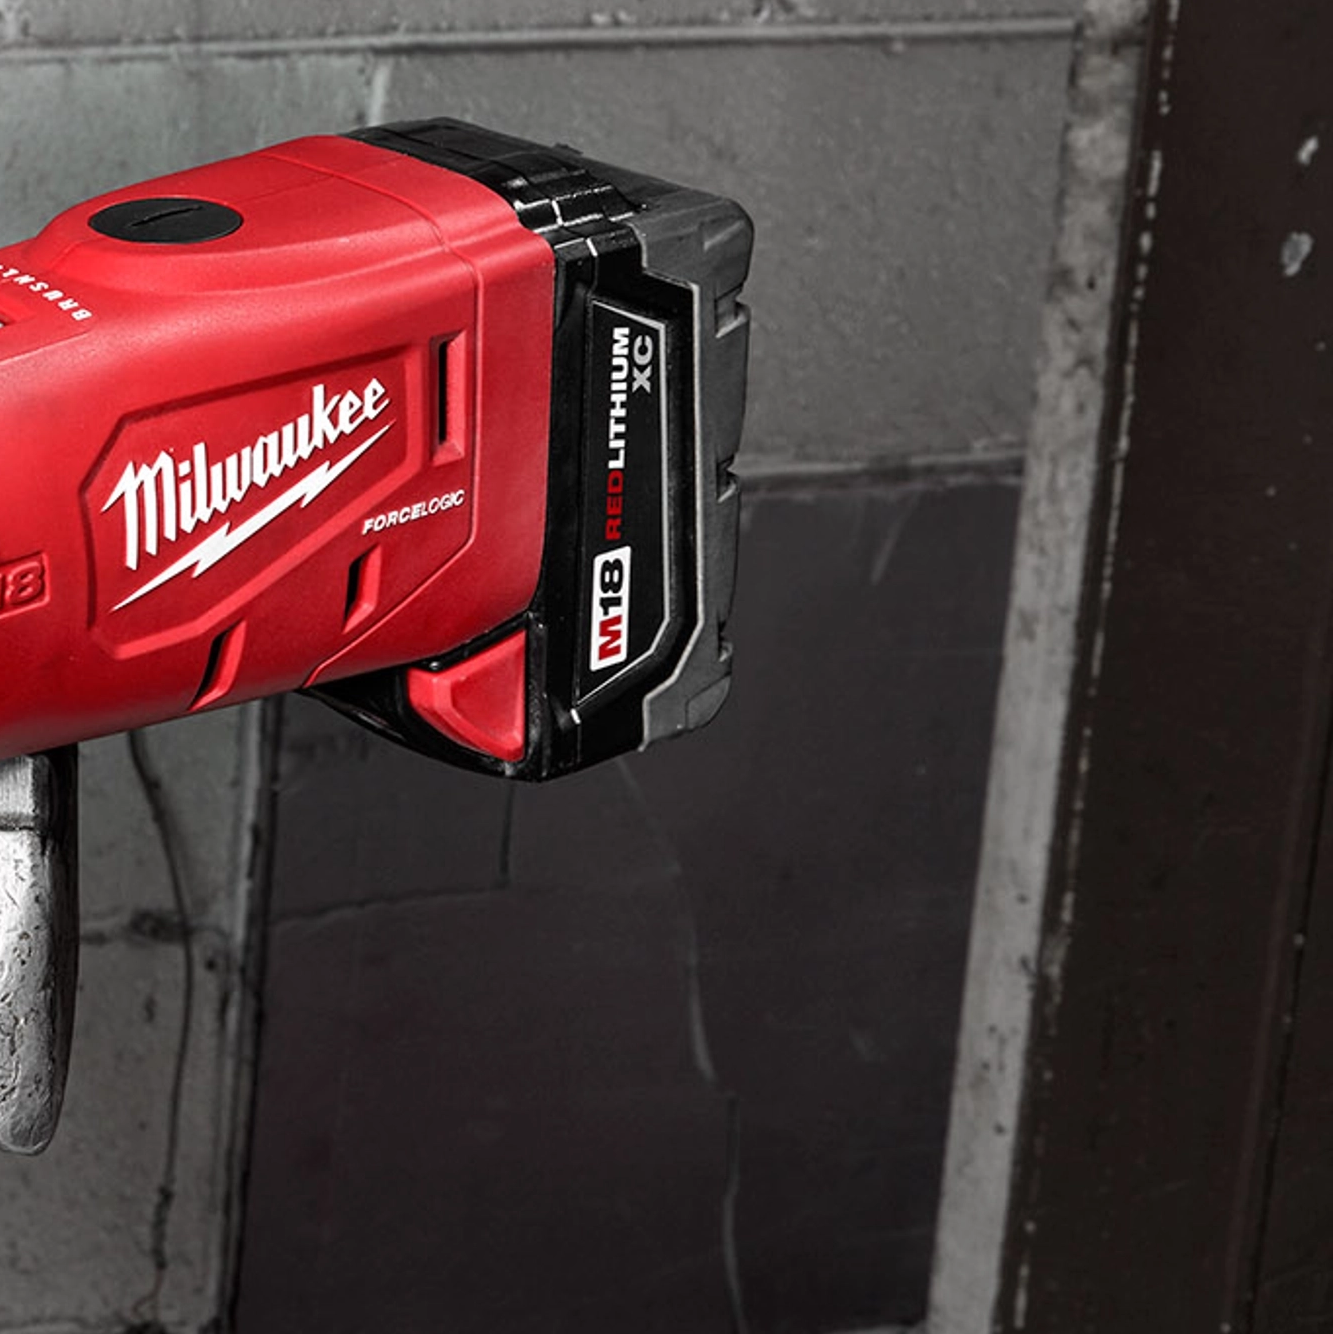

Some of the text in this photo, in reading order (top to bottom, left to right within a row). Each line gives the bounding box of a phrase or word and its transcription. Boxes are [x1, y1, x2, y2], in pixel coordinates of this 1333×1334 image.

[632, 334, 653, 393] XC
[101, 378, 390, 571] Milwaukee
[361, 489, 465, 535] FORCELOGIC
[598, 327, 630, 661] M18 REDLITHIUM
